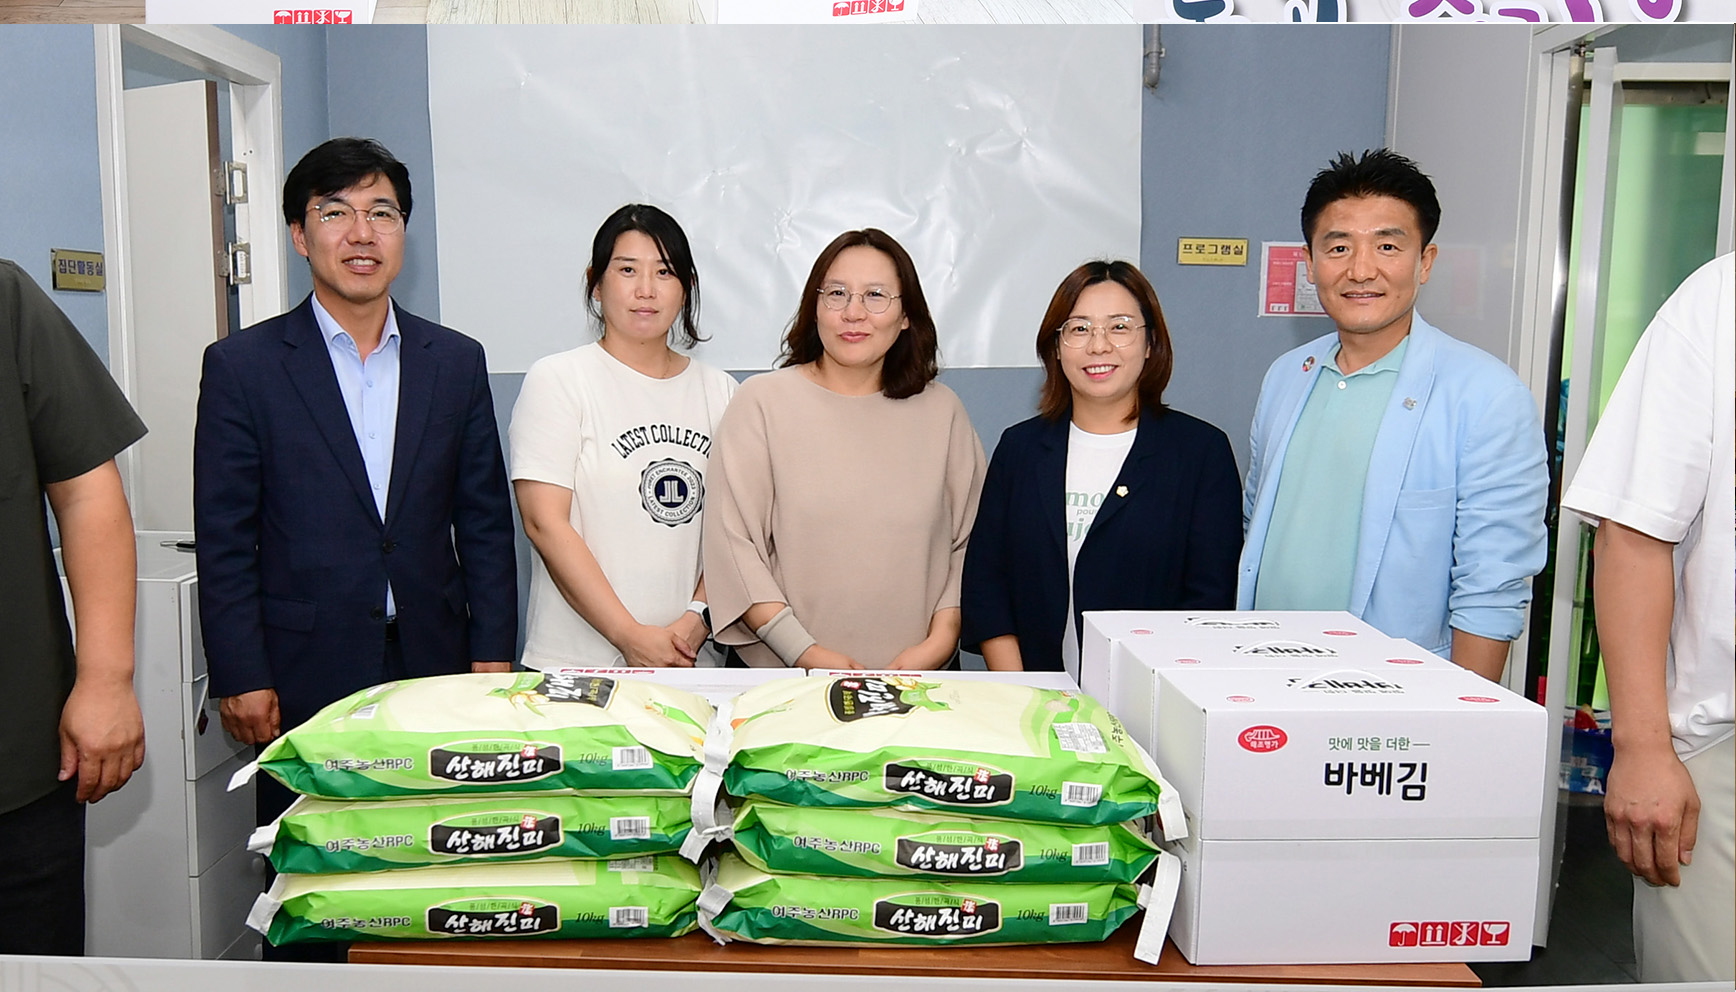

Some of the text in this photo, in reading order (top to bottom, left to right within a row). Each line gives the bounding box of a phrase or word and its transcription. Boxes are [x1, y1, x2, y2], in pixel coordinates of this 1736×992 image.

[1182, 243, 1244, 256] 프로그램실
[58, 258, 103, 277] 집단활동실
[611, 426, 650, 459] LATEST
[1328, 737, 1411, 751] 맛에 맛을 더한
[325, 756, 413, 772] 여주농산RPC
[446, 750, 545, 783] 산해진미
[578, 752, 608, 768] 10kg
[785, 768, 869, 784] 여주농산RPC
[1324, 761, 1428, 801] 바베김
[901, 770, 995, 802] 산해진미
[1028, 783, 1058, 801] 10kg
[577, 821, 606, 837] 10kg
[325, 834, 413, 853] 여주농산RPC
[446, 828, 545, 853] 산해진미
[793, 836, 881, 856] 여주농산RPC
[910, 844, 1006, 872] 산해진미
[1038, 847, 1069, 864] 10kg
[444, 909, 542, 934] 산해진미
[575, 911, 605, 927] 10kg
[771, 904, 859, 922] 여주농산RPC
[889, 907, 984, 933] 산해진미
[1016, 907, 1045, 923] 10kg
[321, 916, 411, 931] 여주농산RPC
